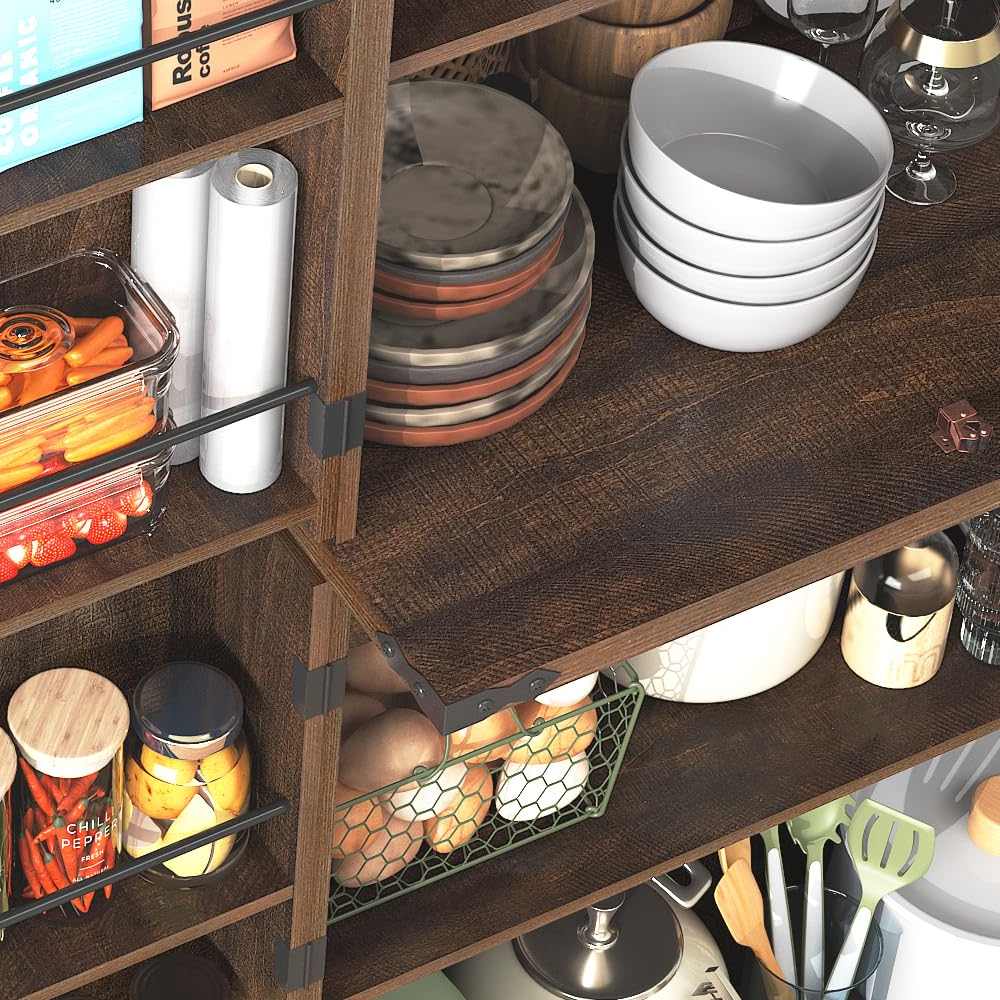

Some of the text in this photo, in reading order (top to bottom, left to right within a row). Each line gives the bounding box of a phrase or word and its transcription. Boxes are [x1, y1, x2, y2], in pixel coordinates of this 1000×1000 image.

[18, 15, 40, 146] ORANIC
[61, 818, 117, 849] PEPPER
[66, 806, 114, 834] CHILLI
[81, 850, 104, 862] FRESH
